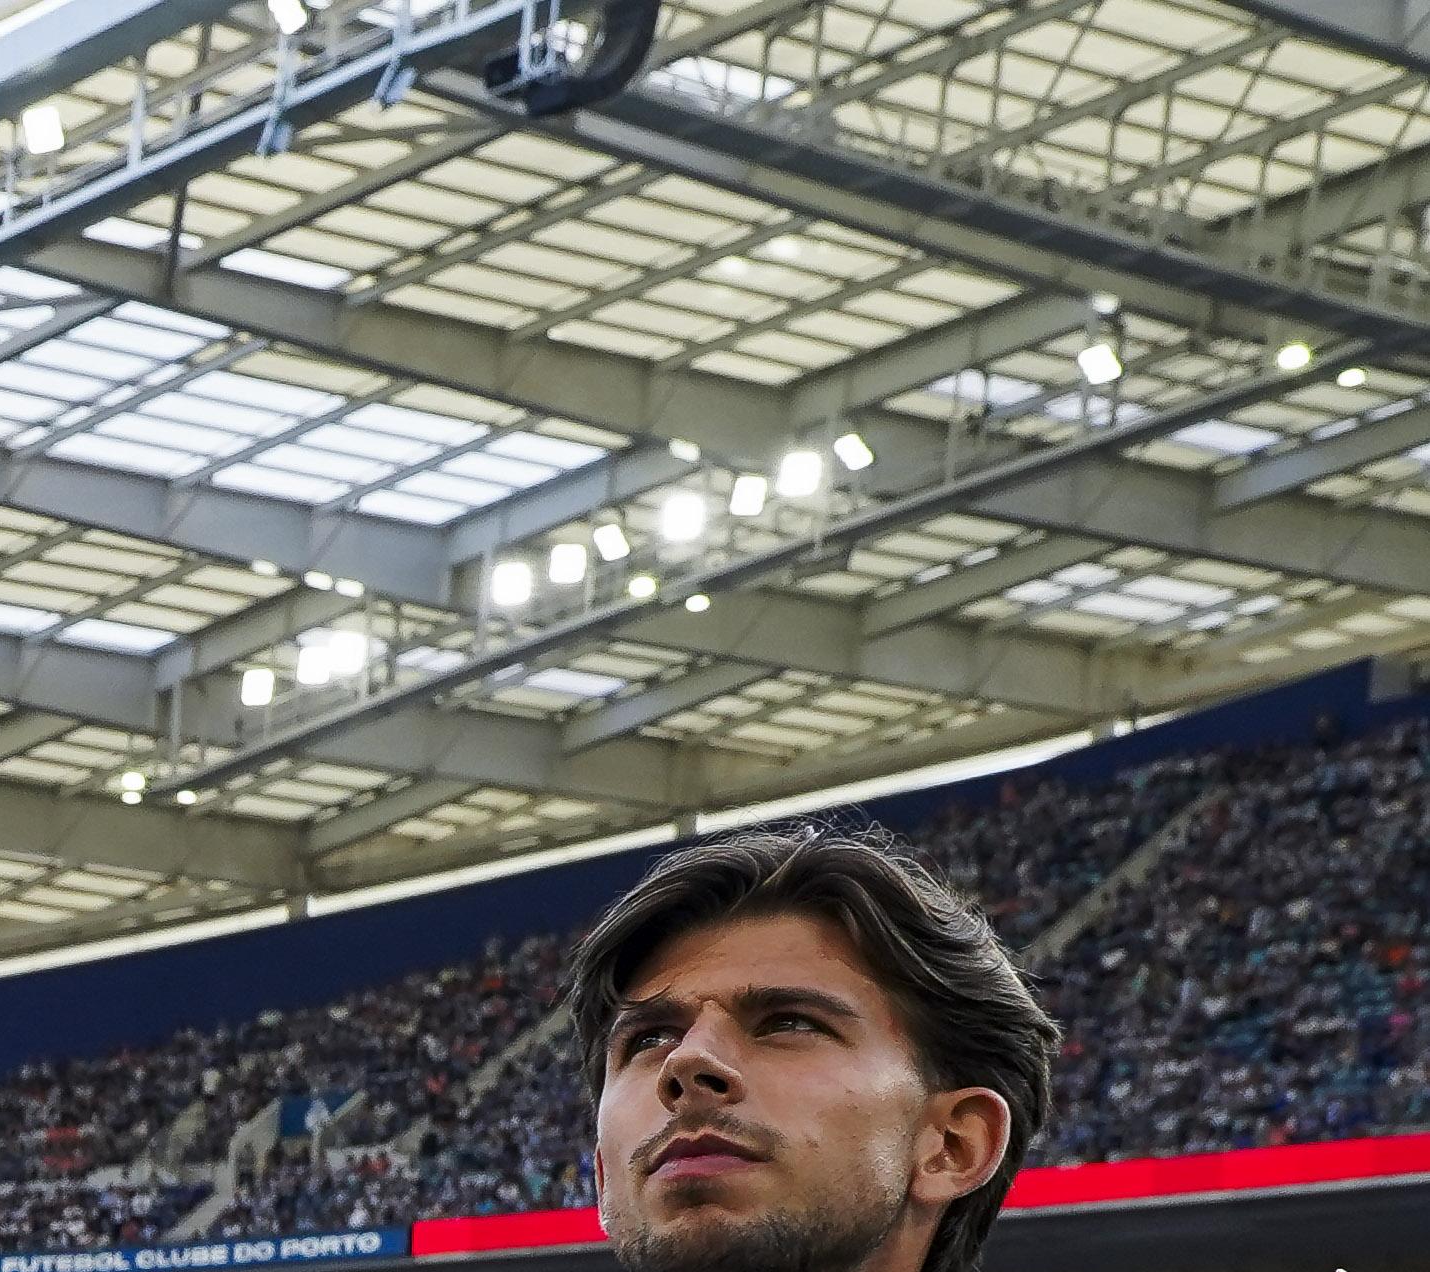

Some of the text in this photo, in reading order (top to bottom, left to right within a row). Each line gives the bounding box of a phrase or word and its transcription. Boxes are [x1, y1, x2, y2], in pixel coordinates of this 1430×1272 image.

[135, 1244, 228, 1268] CLUBE
[235, 1241, 274, 1263] DO
[279, 1232, 380, 1260] PORTO
